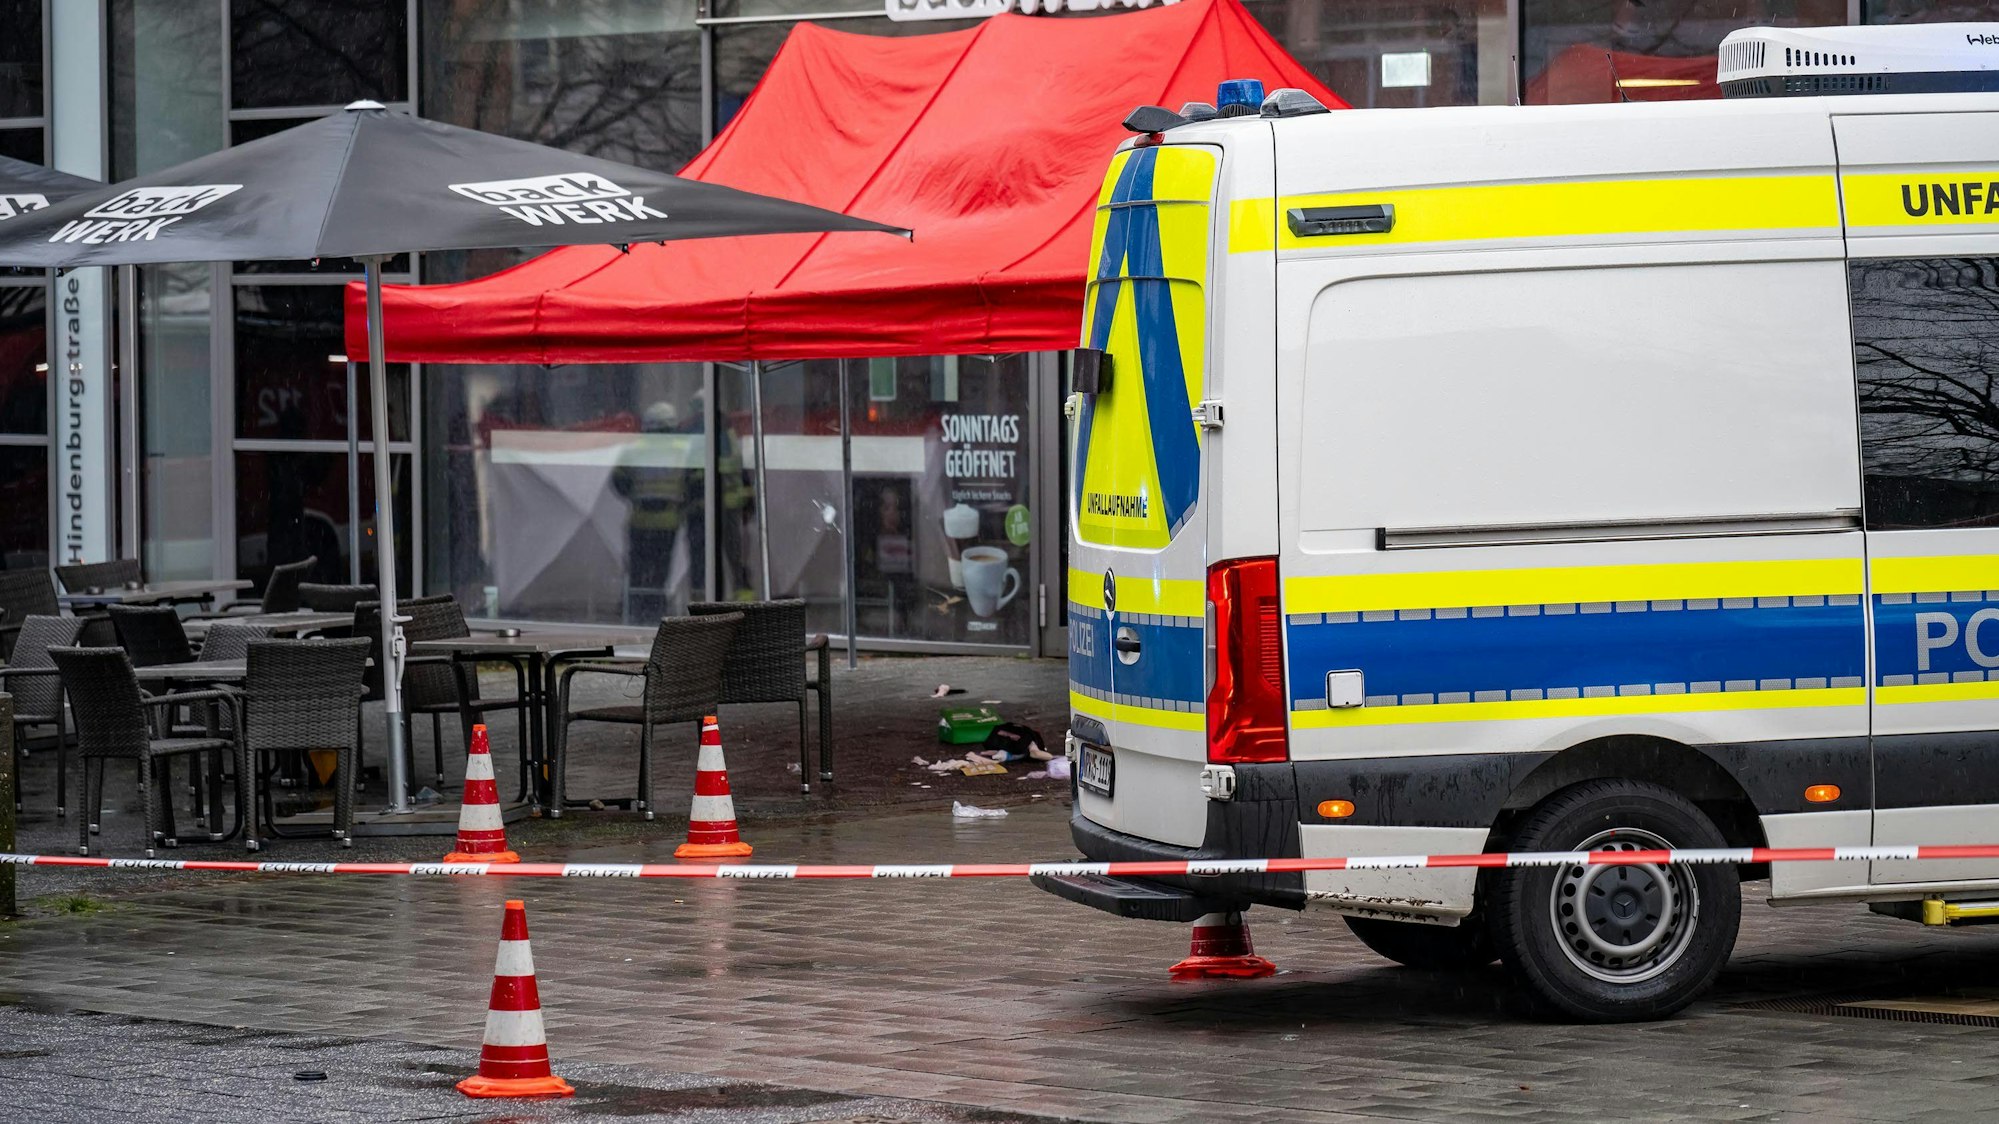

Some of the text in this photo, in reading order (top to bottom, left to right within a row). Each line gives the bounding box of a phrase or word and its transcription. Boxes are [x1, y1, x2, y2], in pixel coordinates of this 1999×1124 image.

[1966, 34, 1999, 46] Web
[93, 186, 221, 215] back
[458, 176, 624, 202] back
[1901, 182, 1999, 217] UNFA
[499, 196, 668, 226] WERK
[49, 216, 183, 244] WERK
[941, 415, 1019, 444] SONNTAGS
[945, 444, 1016, 478] GEÖFFNET
[1087, 492, 1148, 518] UNFALLAUFNAHME
[1069, 618, 1095, 657] POLIZEI
[1915, 608, 1999, 671] PO
